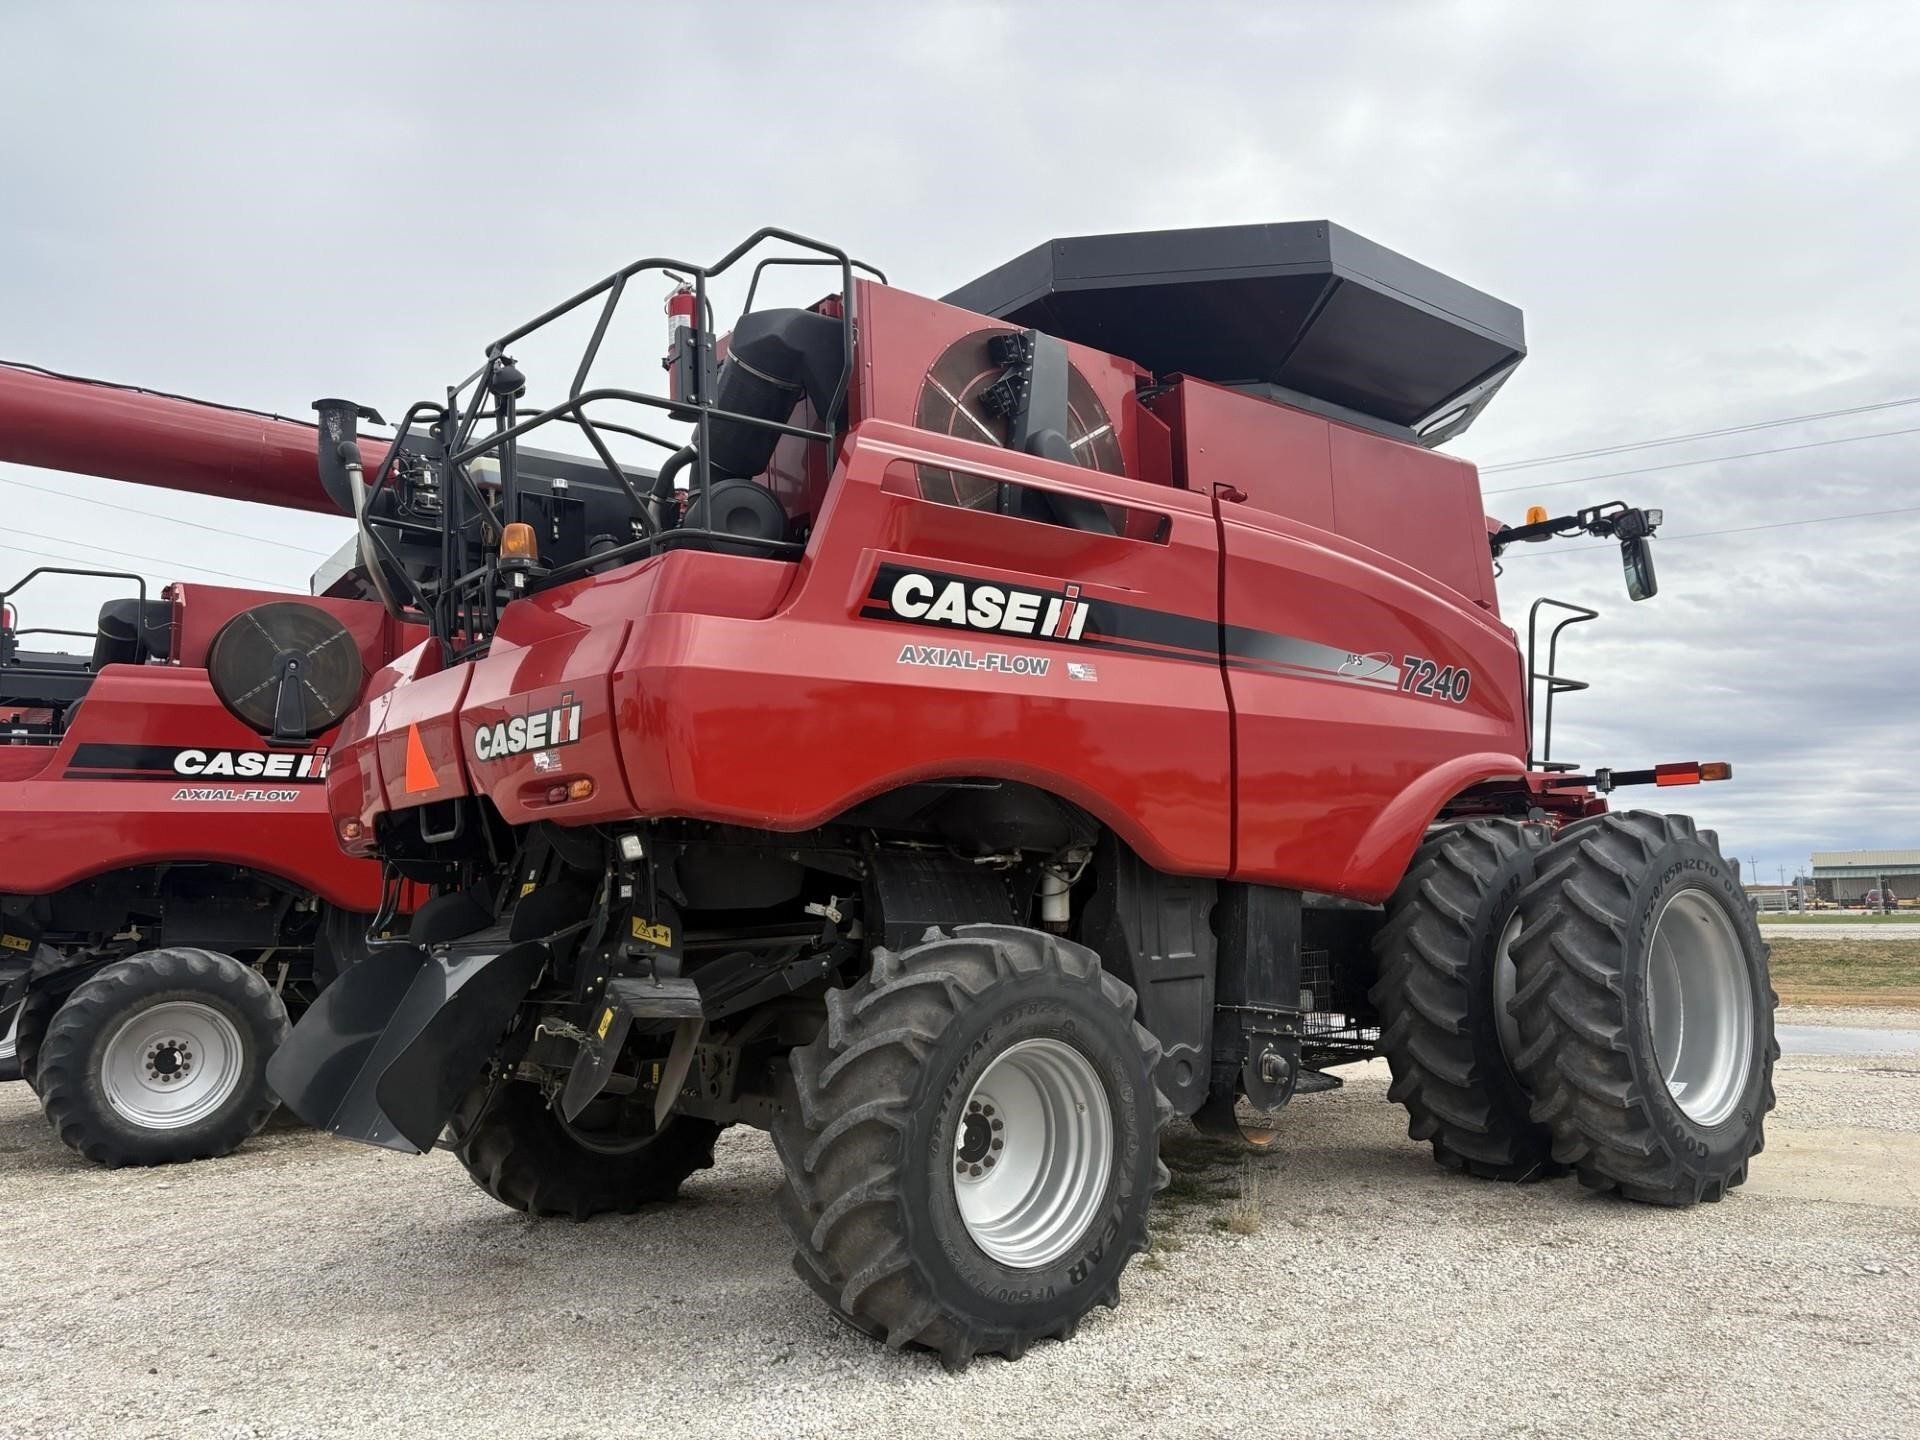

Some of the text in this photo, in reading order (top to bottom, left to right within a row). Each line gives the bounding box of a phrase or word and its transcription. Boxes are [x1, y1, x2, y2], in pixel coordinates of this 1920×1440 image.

[890, 573, 1042, 630] CASE
[897, 644, 1050, 676] AXIAL-FLOW
[1346, 653, 1364, 666] AFS
[1402, 655, 1472, 704] 7240
[475, 712, 548, 761] CASE
[173, 749, 295, 777] CASE
[171, 788, 300, 802] AXIAL-FLOW
